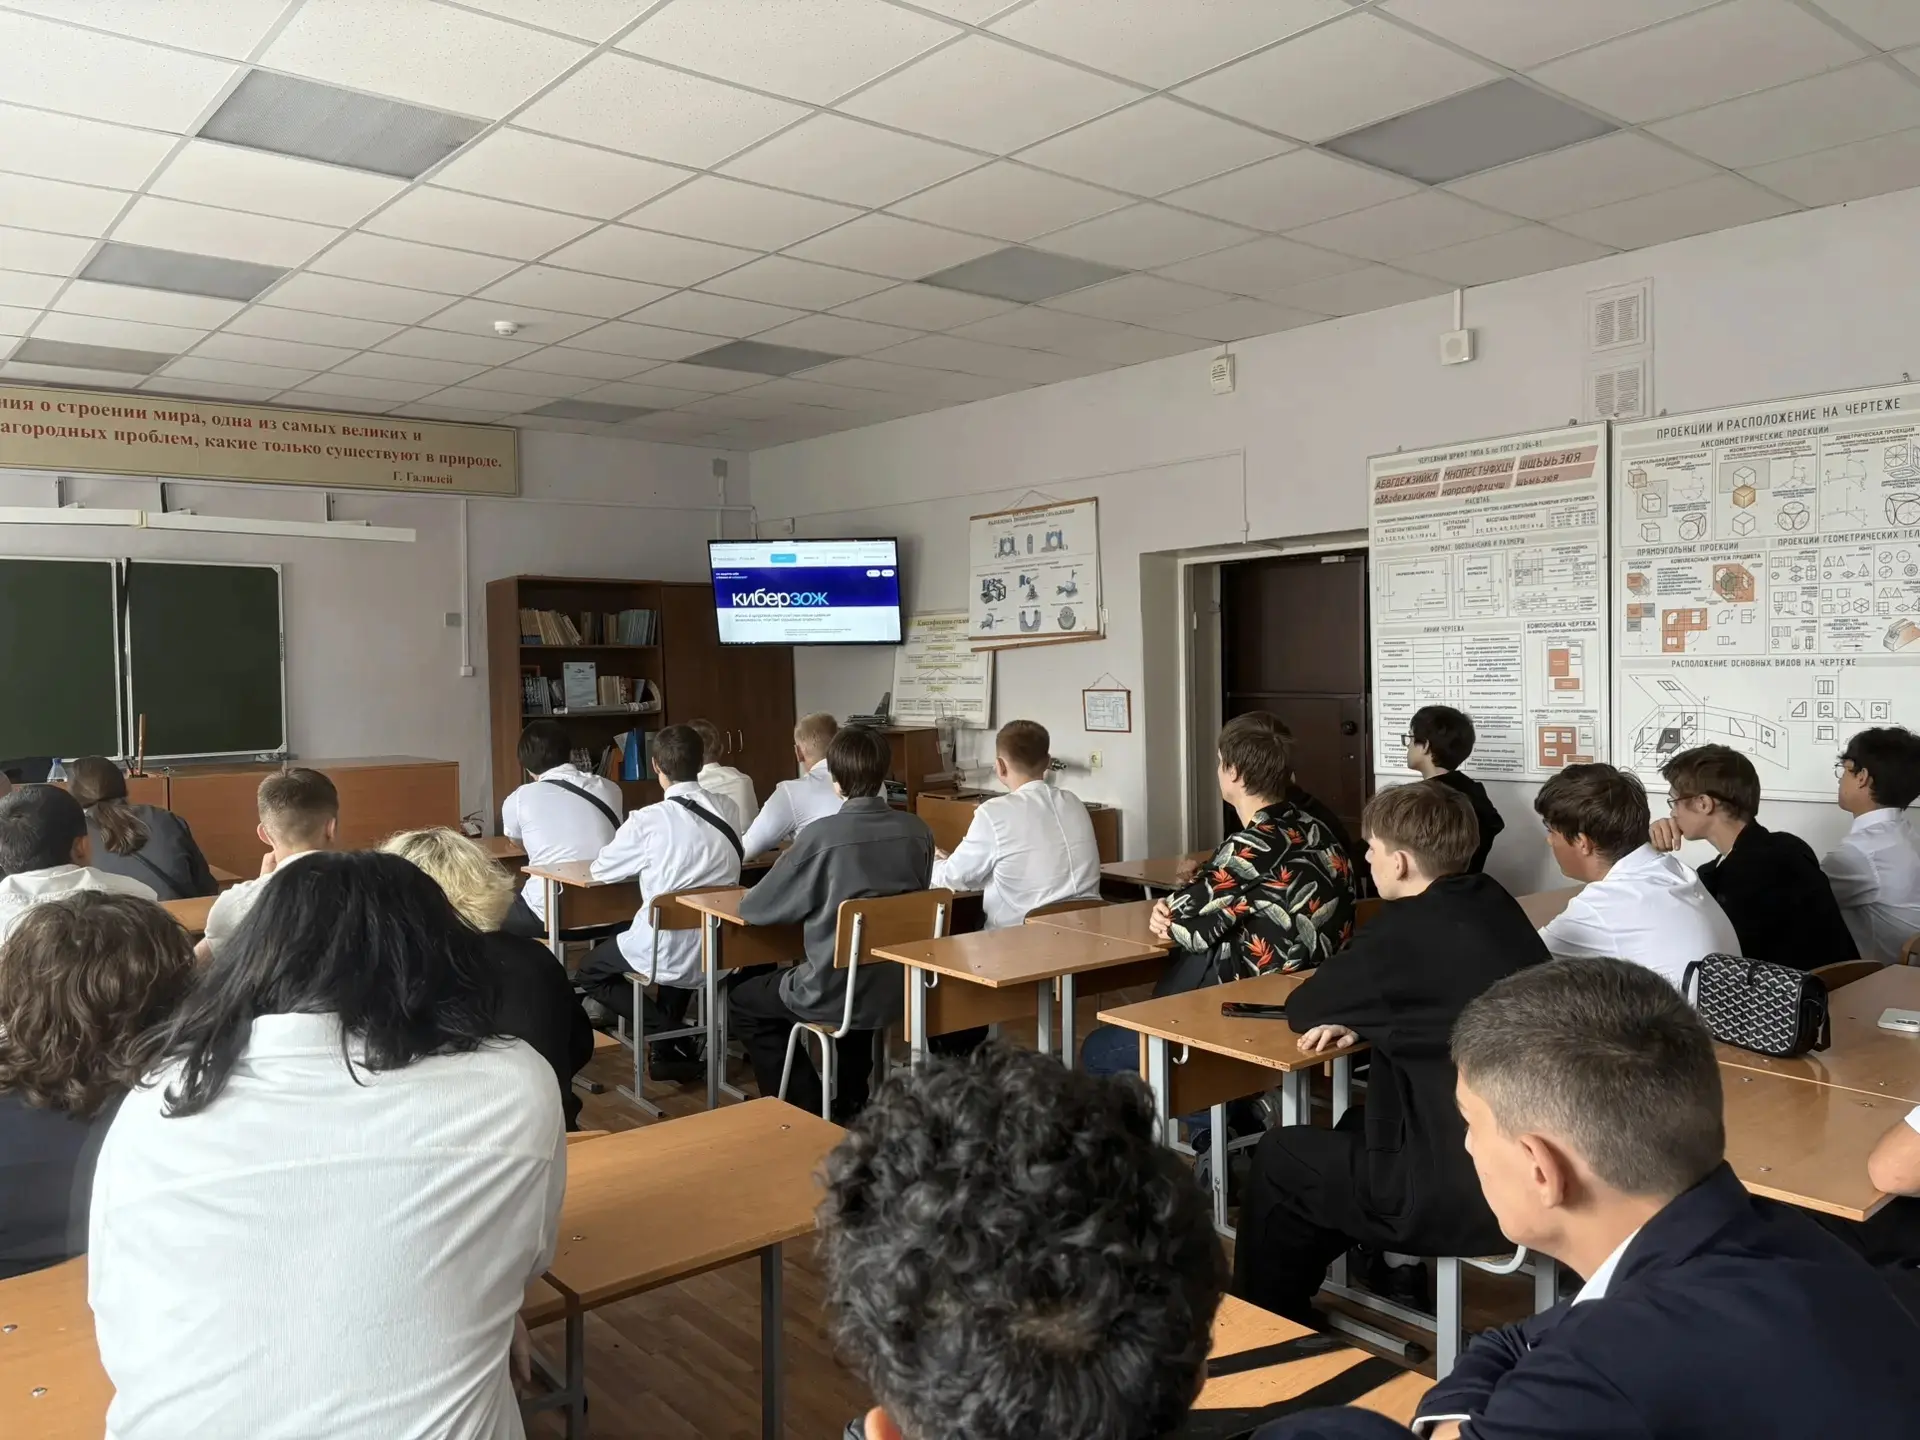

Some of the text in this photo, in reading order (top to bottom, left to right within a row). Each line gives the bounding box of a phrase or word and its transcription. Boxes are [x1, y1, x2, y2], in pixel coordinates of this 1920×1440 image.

[41, 401, 50, 411] о
[57, 402, 147, 419] строении
[153, 410, 206, 427] мира,
[212, 415, 252, 428] одна
[259, 419, 277, 430] из
[282, 421, 336, 434] самых
[342, 426, 407, 440] великих
[413, 432, 422, 441] и
[1657, 398, 1900, 439] ПРОЕКЦИИ И РАСПОЛОЖЕНИЕ НА ЧЕРТЕЖЕ
[1701, 426, 1829, 448] АКСОНОМЕТРИЧЕСКИЕ ПРОЕКЦИИ
[114, 429, 199, 448] проблем,
[205, 437, 257, 450] какие
[262, 441, 321, 454] только
[326, 446, 420, 463] существуют
[426, 453, 434, 462] в
[439, 454, 502, 468] природе.
[393, 471, 453, 484] Г. Галилей
[1778, 530, 1920, 546] ПРОЕКЦИИ ГЕОМЕТРИЧЕСКИХ ТЕЛ
[1637, 542, 1739, 556] ПРЯМОУГОЛЬНЫЕ ПРОЕКЦИИ
[732, 588, 829, 608] киберзож
[1672, 660, 1727, 668] РАСПОЛОЖЕНИЕ
[1775, 659, 1801, 667] ВИДОВ
[1820, 658, 1856, 666] ЧЕРТЕЖЕ
